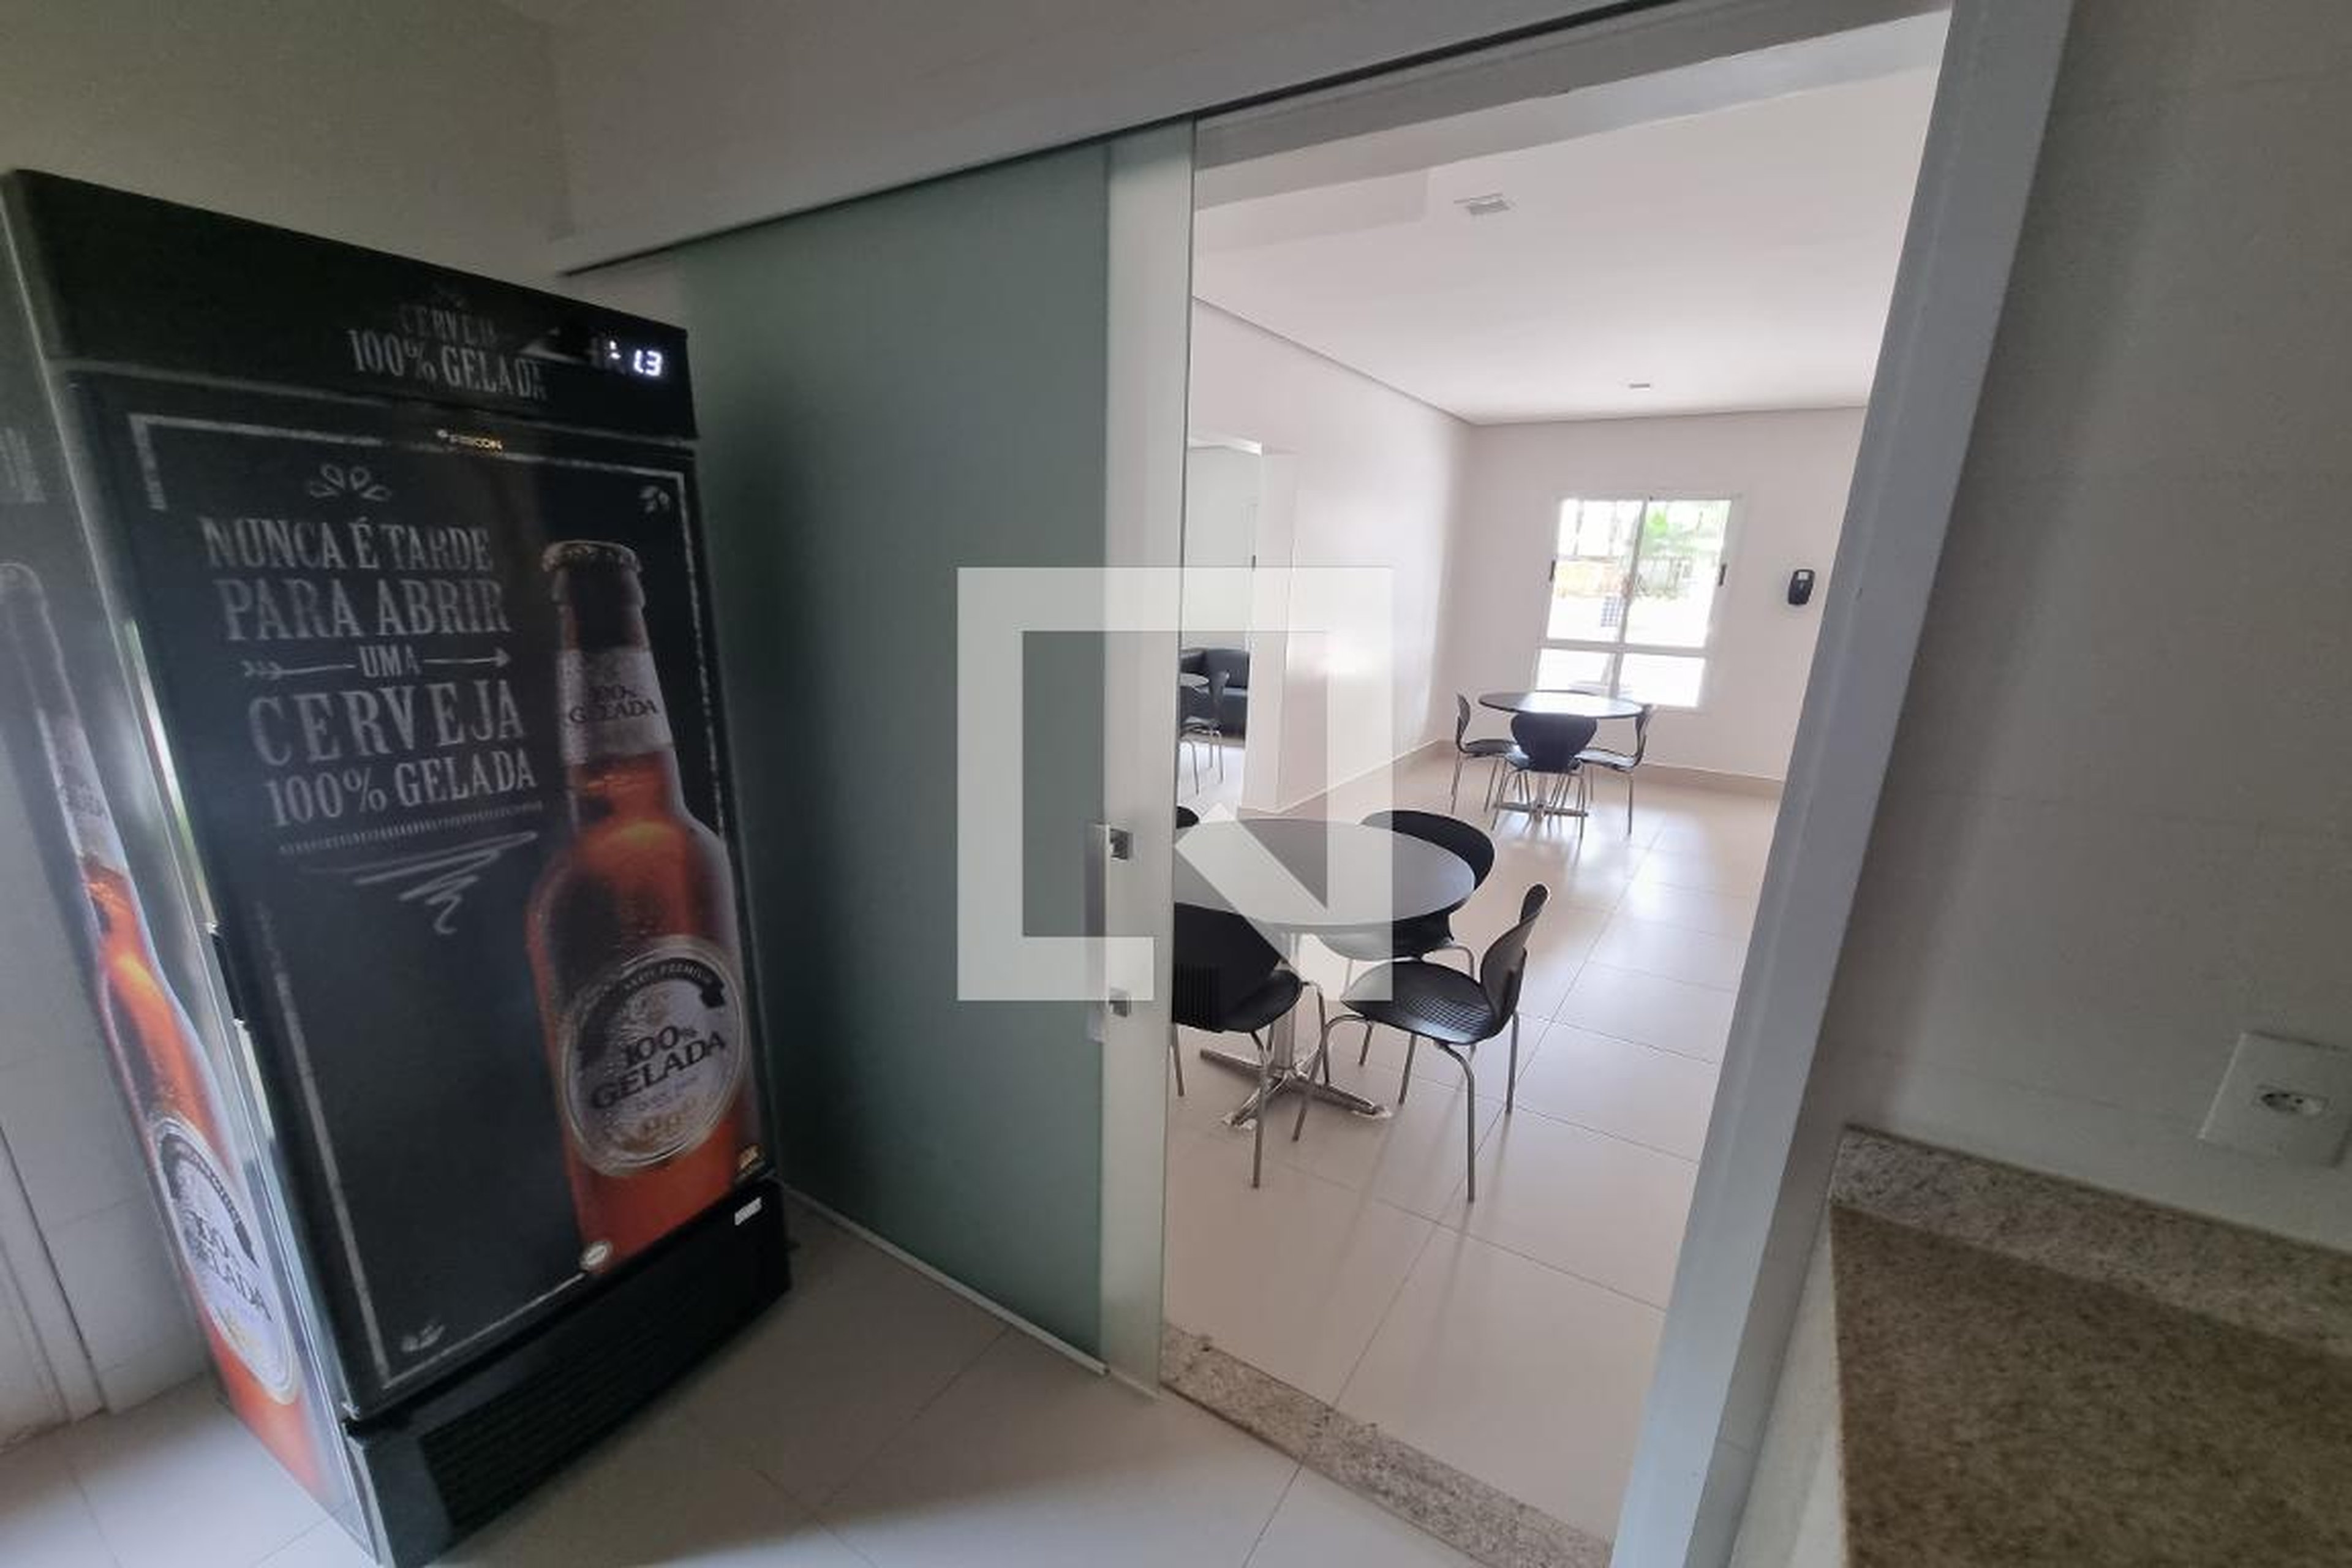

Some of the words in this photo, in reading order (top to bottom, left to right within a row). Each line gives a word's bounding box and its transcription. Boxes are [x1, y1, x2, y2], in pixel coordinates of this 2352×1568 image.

[197, 516, 347, 570] NUNCA
[349, 516, 377, 570] É
[380, 524, 493, 571] TARDE
[213, 579, 364, 641] PARA
[375, 579, 512, 636] ABRIR
[358, 645, 423, 679] UMA
[248, 679, 524, 766] CERVEJA
[264, 767, 387, 827] 100%
[394, 748, 538, 807] GELADA
[591, 1031, 726, 1109] GELADA
